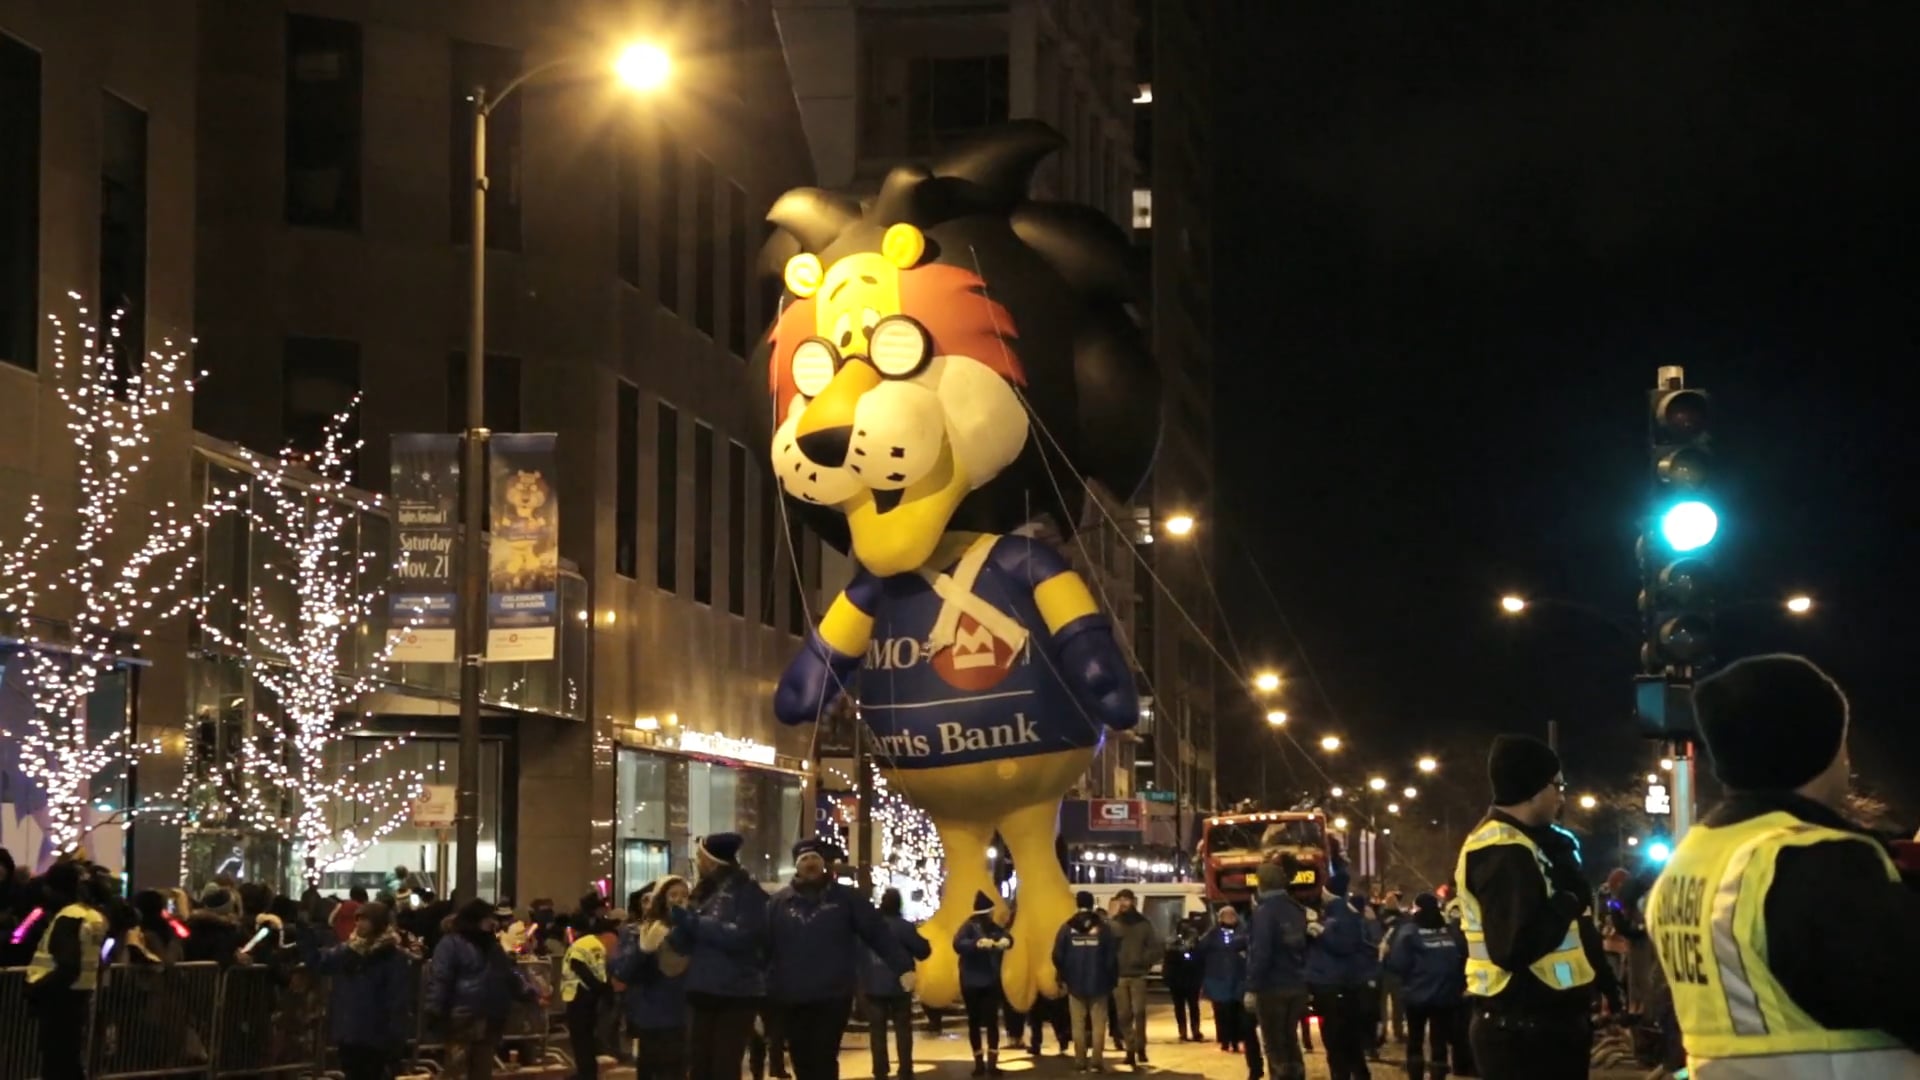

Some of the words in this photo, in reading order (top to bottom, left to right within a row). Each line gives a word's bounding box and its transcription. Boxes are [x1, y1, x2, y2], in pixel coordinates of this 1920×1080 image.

[399, 532, 452, 553] Saturday
[398, 556, 430, 578] Nov.
[433, 556, 449, 578] 21
[864, 636, 920, 670] MO
[870, 728, 931, 758] arris
[936, 713, 1041, 755] Bank
